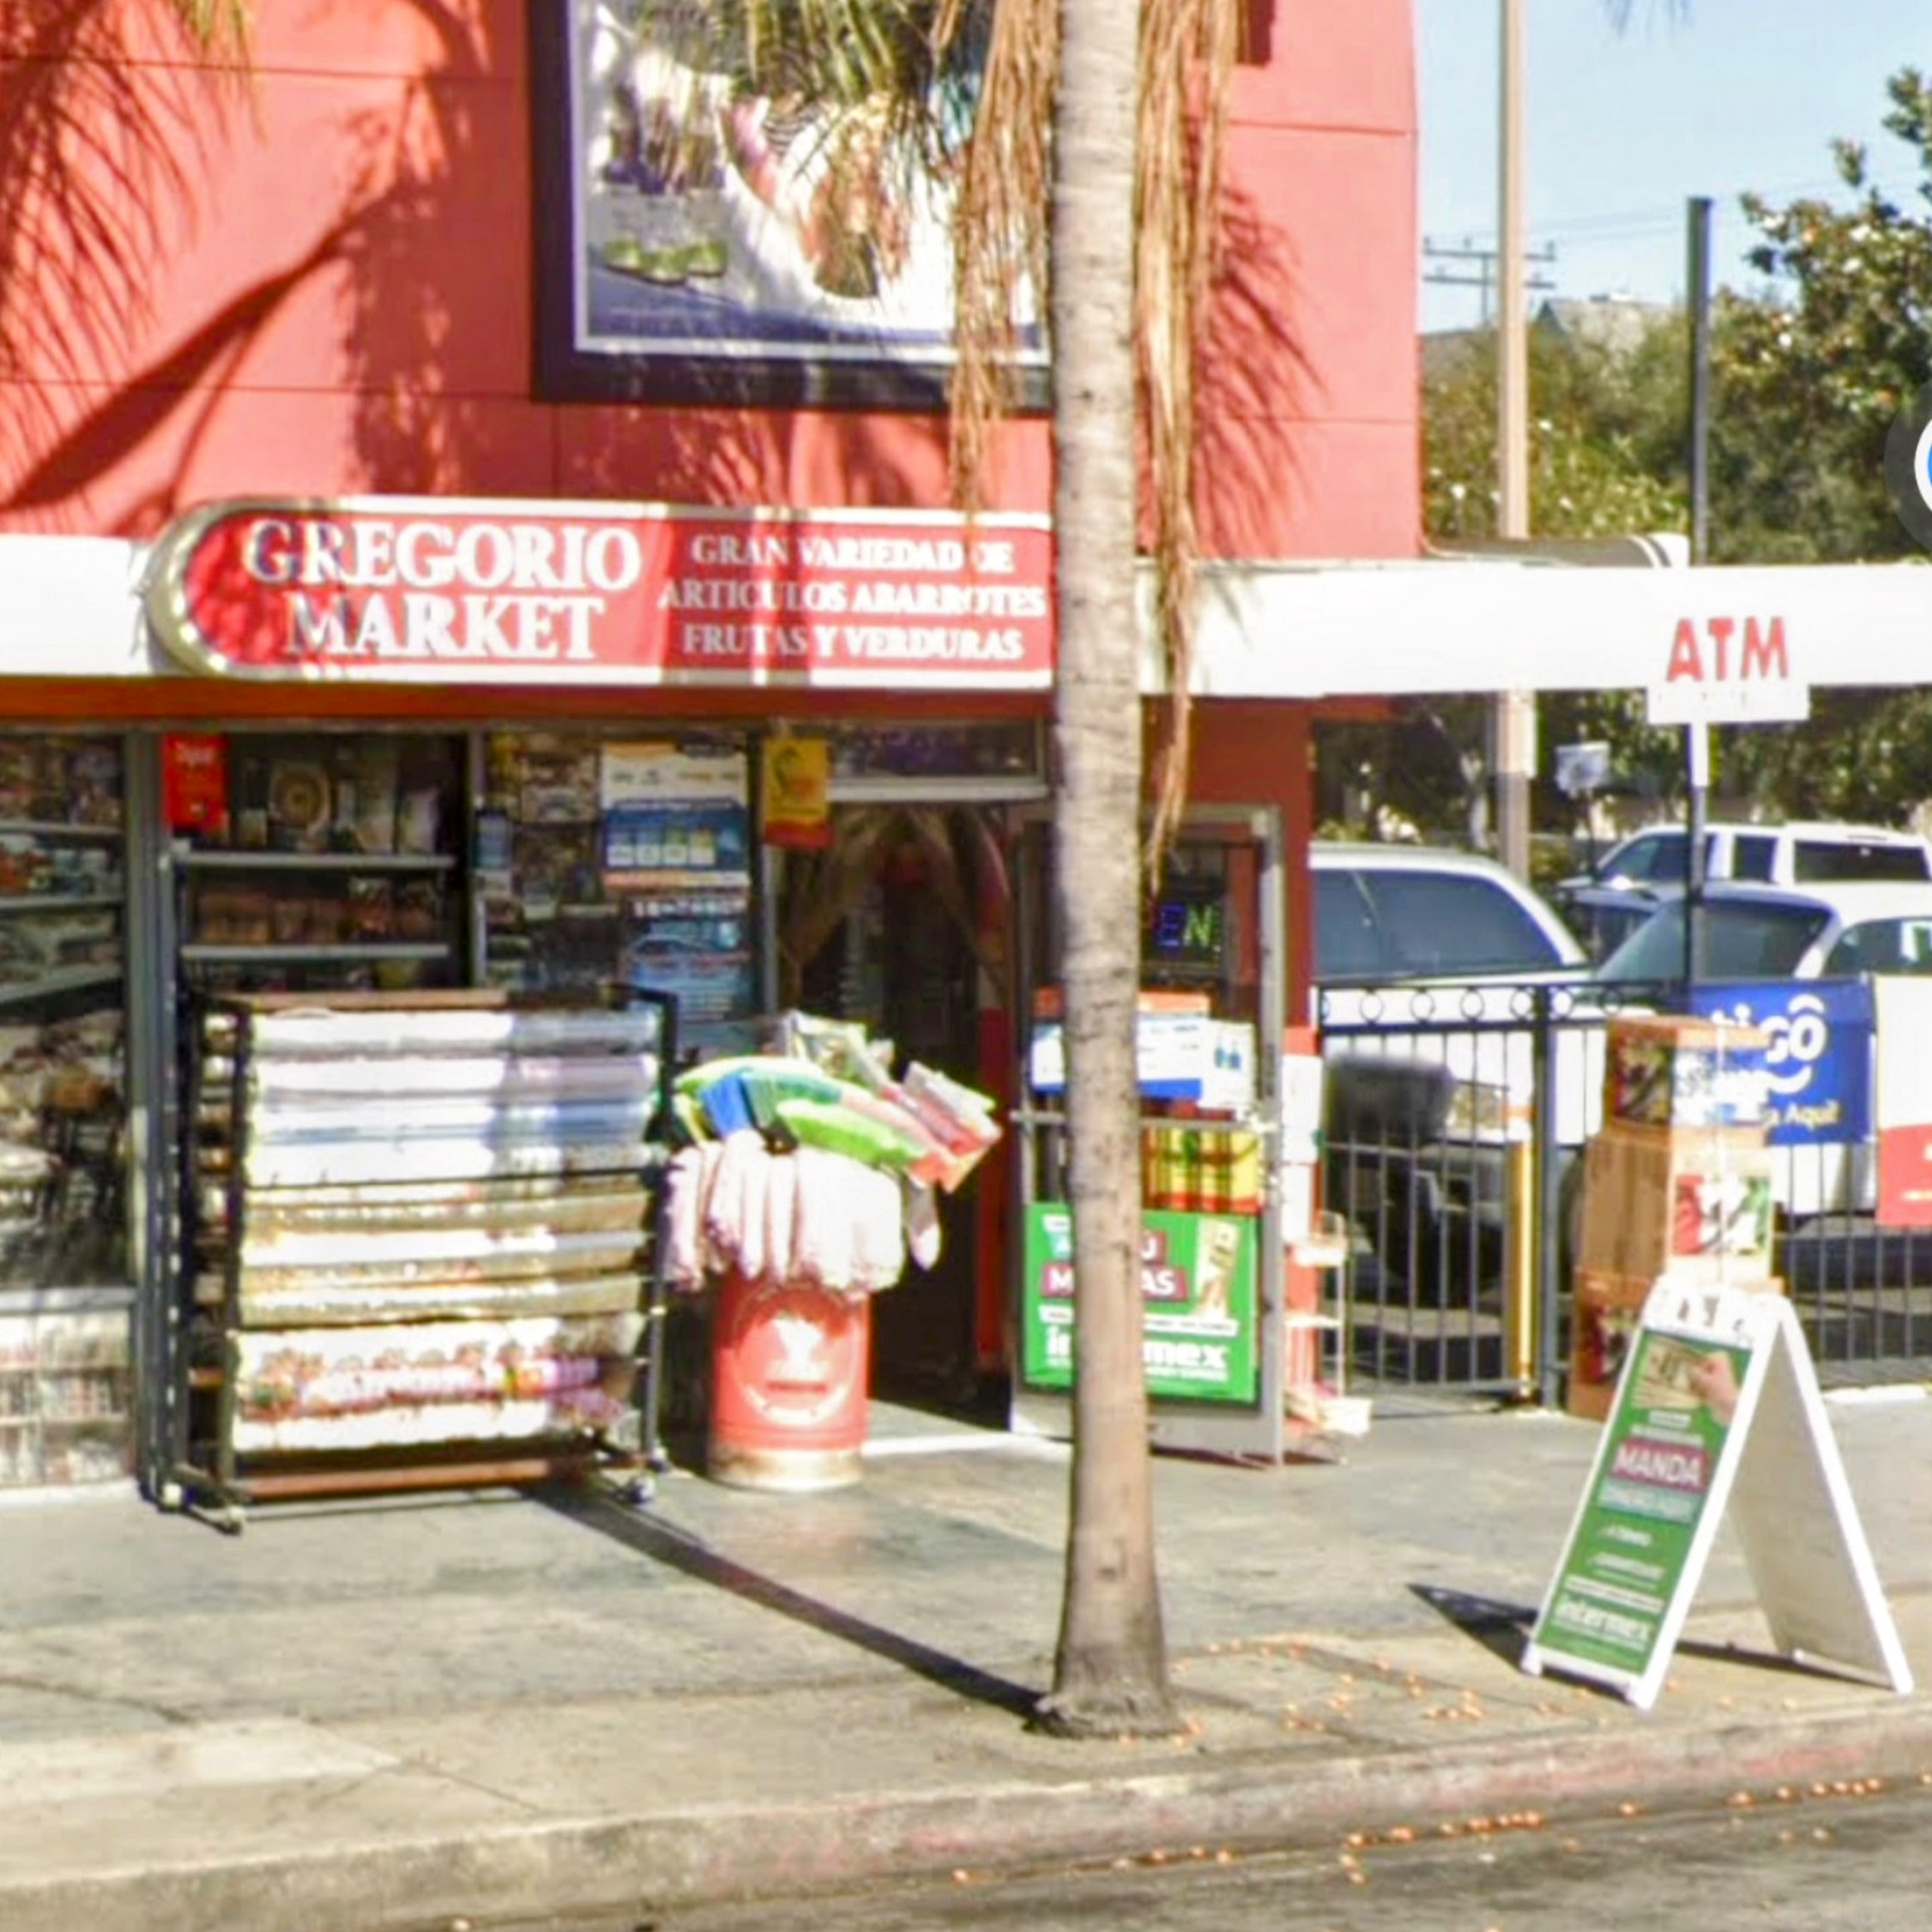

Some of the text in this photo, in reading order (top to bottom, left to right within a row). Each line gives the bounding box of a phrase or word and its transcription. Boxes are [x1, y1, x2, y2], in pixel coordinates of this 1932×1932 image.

[243, 519, 640, 590] GREGORIO
[691, 534, 1014, 573] GRAN VARIEDAD DE
[658, 579, 1046, 617] ARTICULOS ABARROTES
[283, 592, 606, 659] MARKET
[682, 623, 1024, 660] FRUTAS Y VERDURAS
[1665, 616, 1789, 682] ATM
[1159, 903, 1215, 949] EN
[1613, 1445, 1702, 1489] MANDA
